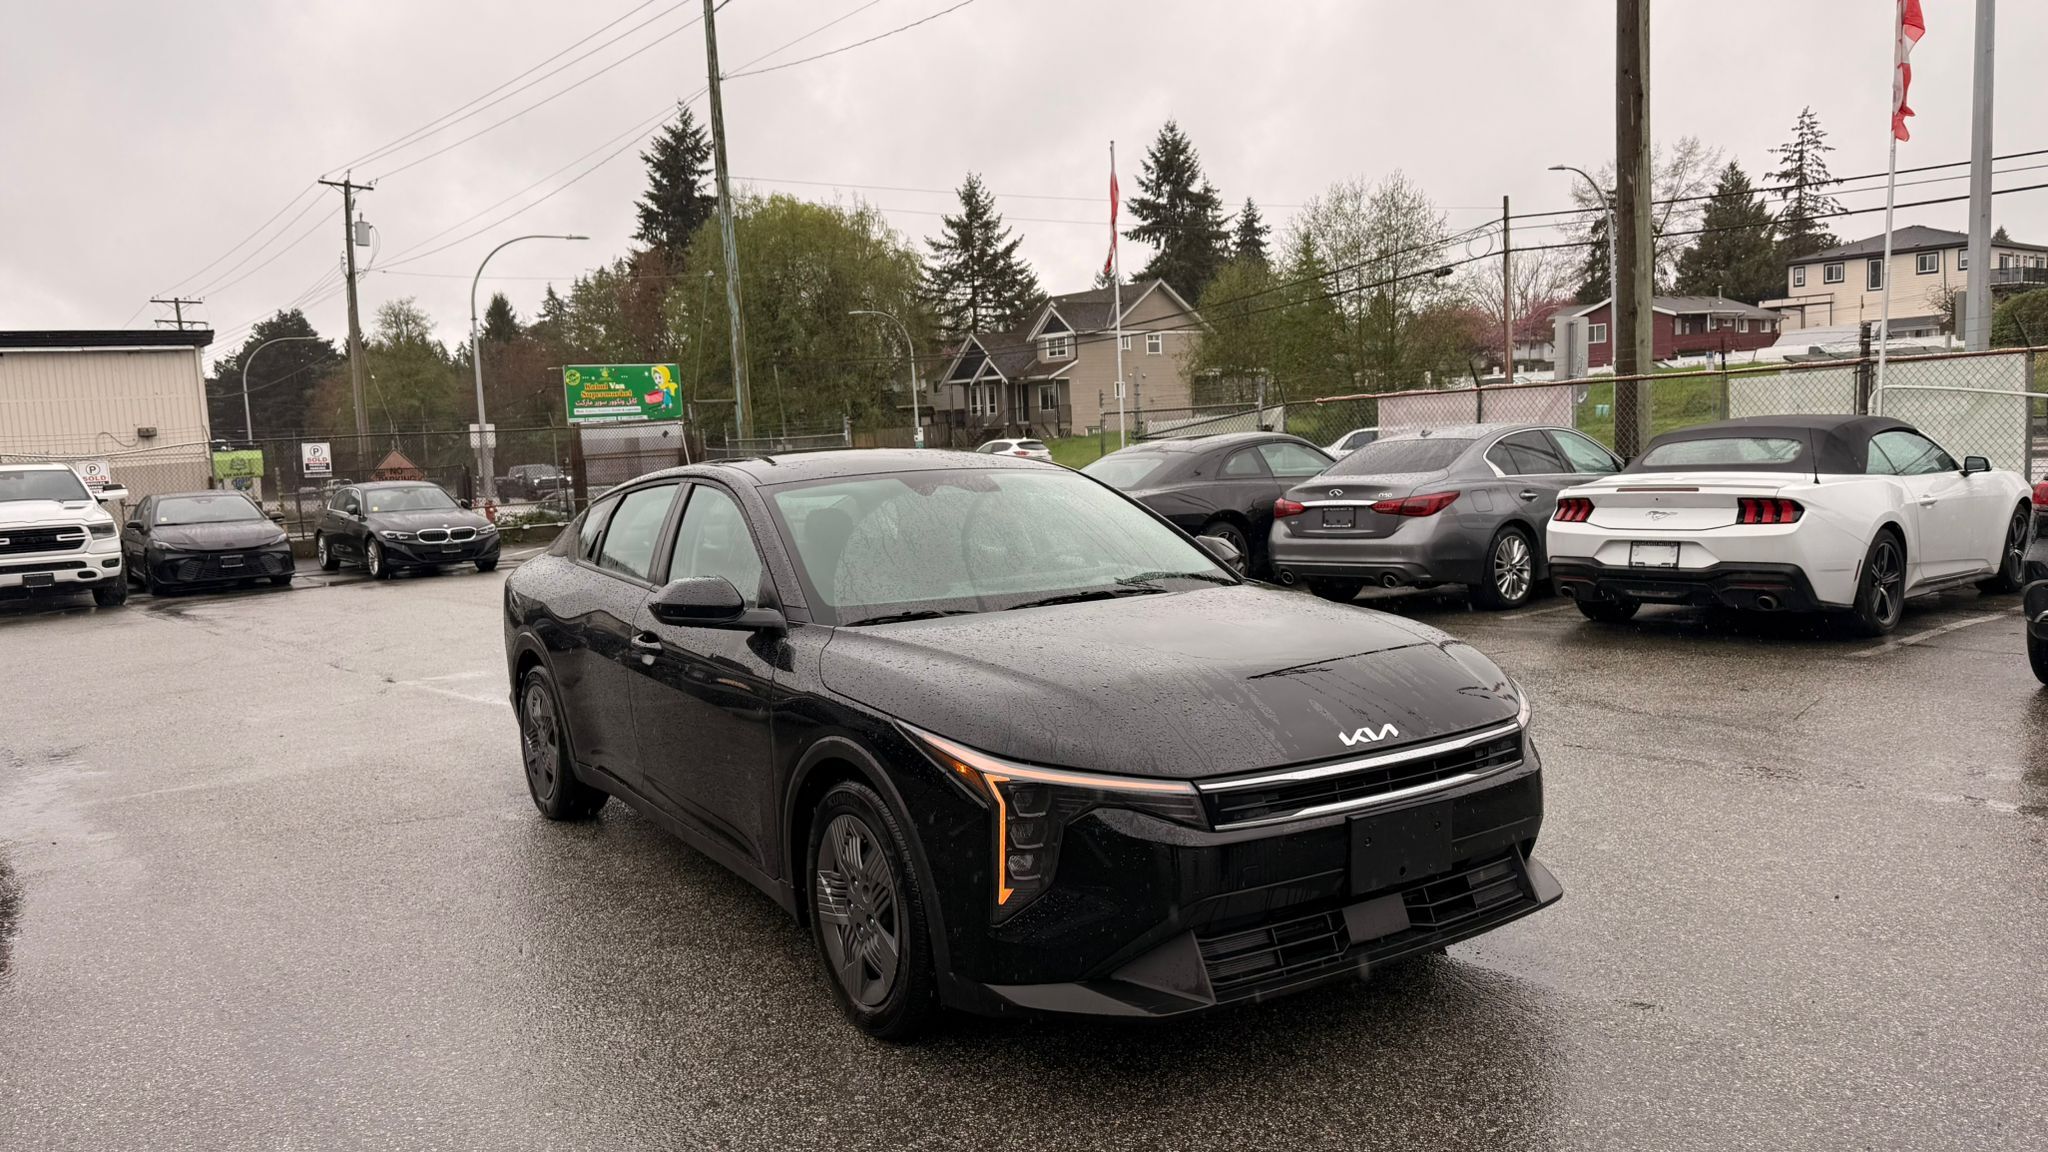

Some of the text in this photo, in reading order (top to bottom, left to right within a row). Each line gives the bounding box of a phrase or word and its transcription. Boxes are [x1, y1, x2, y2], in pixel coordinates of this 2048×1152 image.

[609, 381, 625, 389] Van
[581, 390, 633, 399] Supermarket
[1338, 723, 1400, 746] KIA
